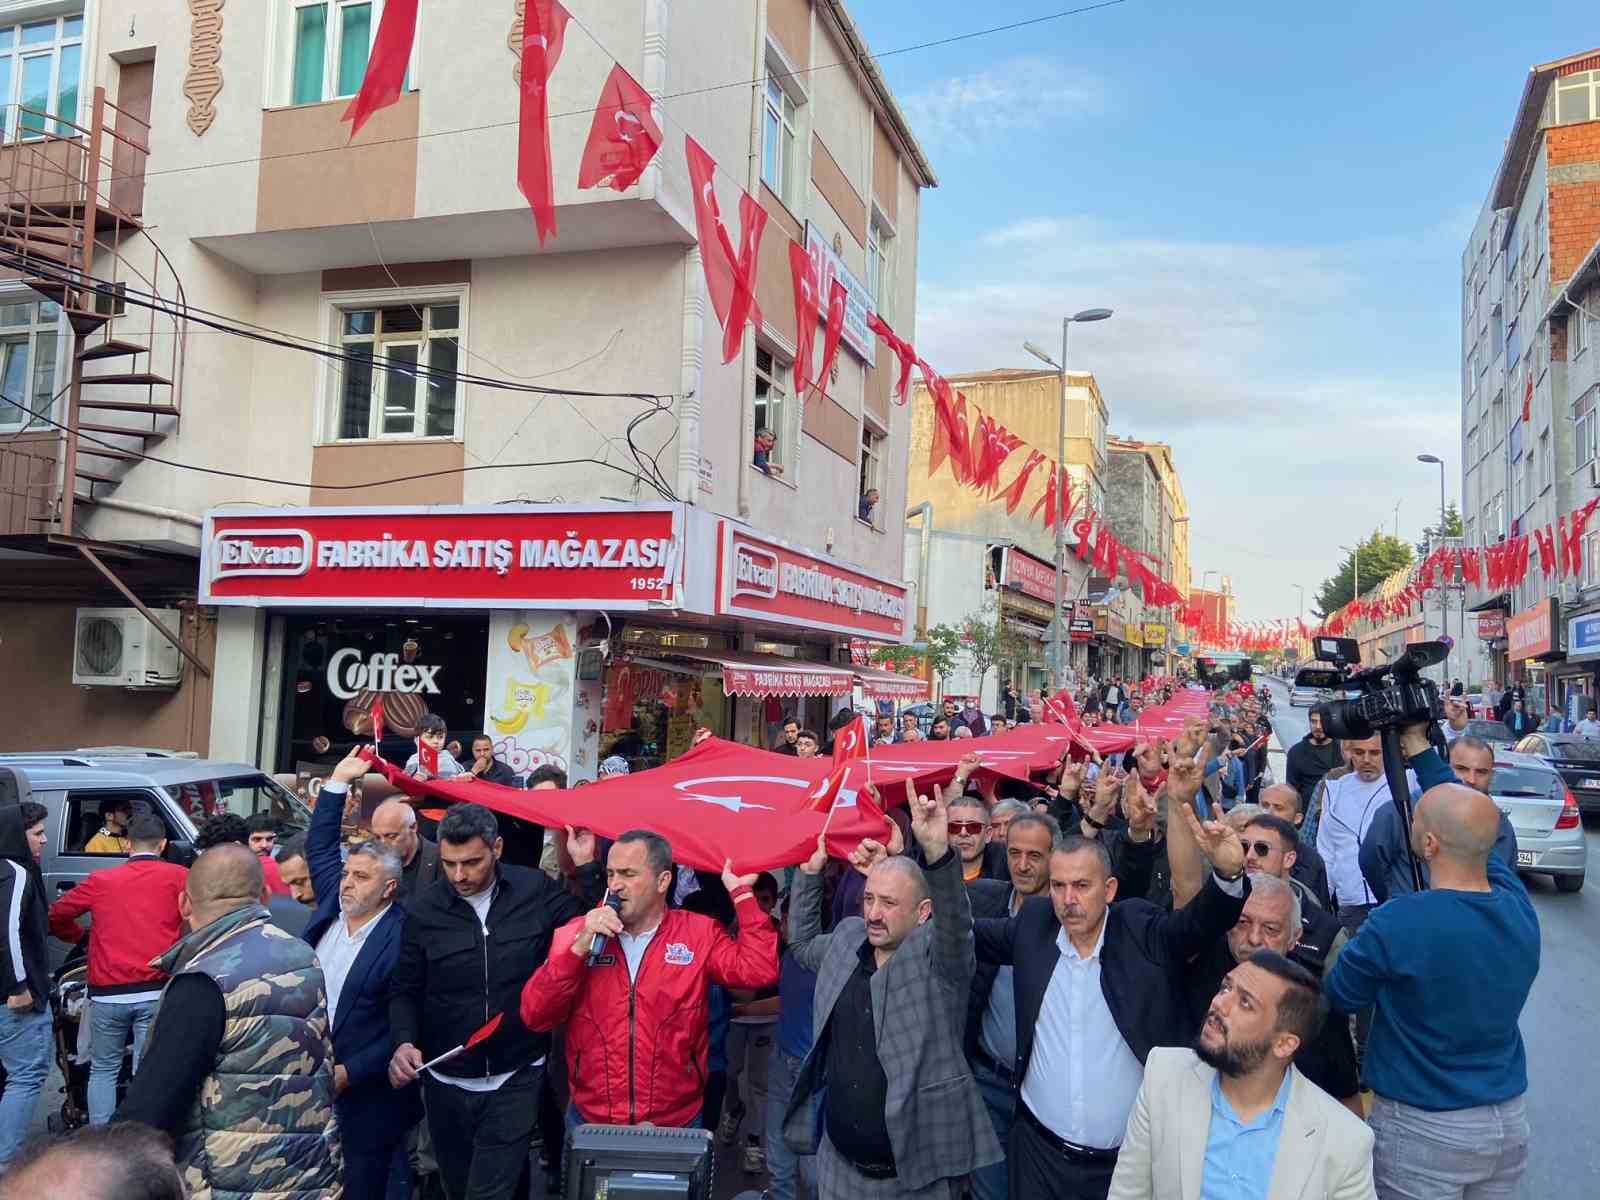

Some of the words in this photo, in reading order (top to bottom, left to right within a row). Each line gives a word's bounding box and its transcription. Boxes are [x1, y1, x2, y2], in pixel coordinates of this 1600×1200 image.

[221, 540, 302, 566] Elvan
[317, 533, 430, 568] FABRİKA
[433, 538, 513, 576] SATIŞ
[520, 530, 667, 568] MAĞAZASI
[630, 577, 664, 591] 1952
[327, 647, 442, 700] Coffex
